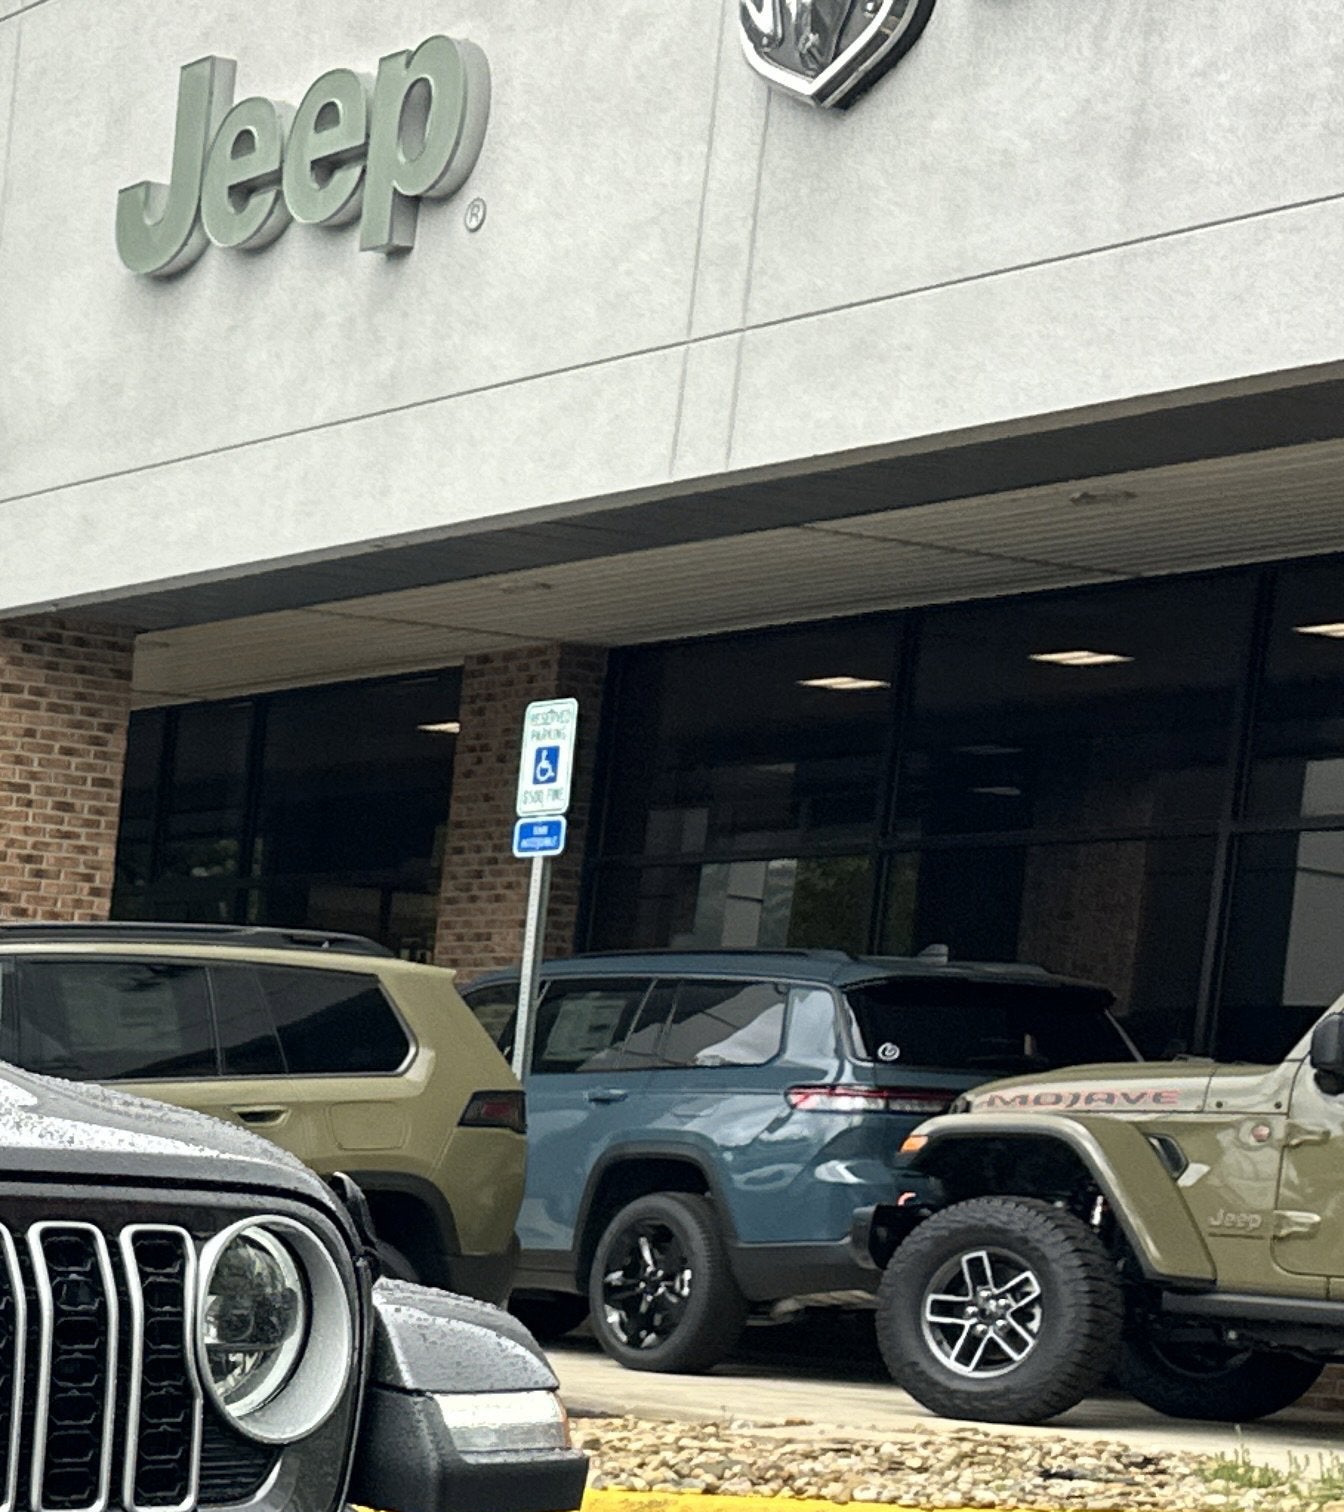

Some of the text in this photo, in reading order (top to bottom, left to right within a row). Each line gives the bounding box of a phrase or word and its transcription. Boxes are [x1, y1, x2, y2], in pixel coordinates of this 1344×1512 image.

[116, 34, 486, 277] Jeep
[986, 1089, 1181, 1108] MOJAVE
[1208, 1209, 1263, 1230] Jeep
